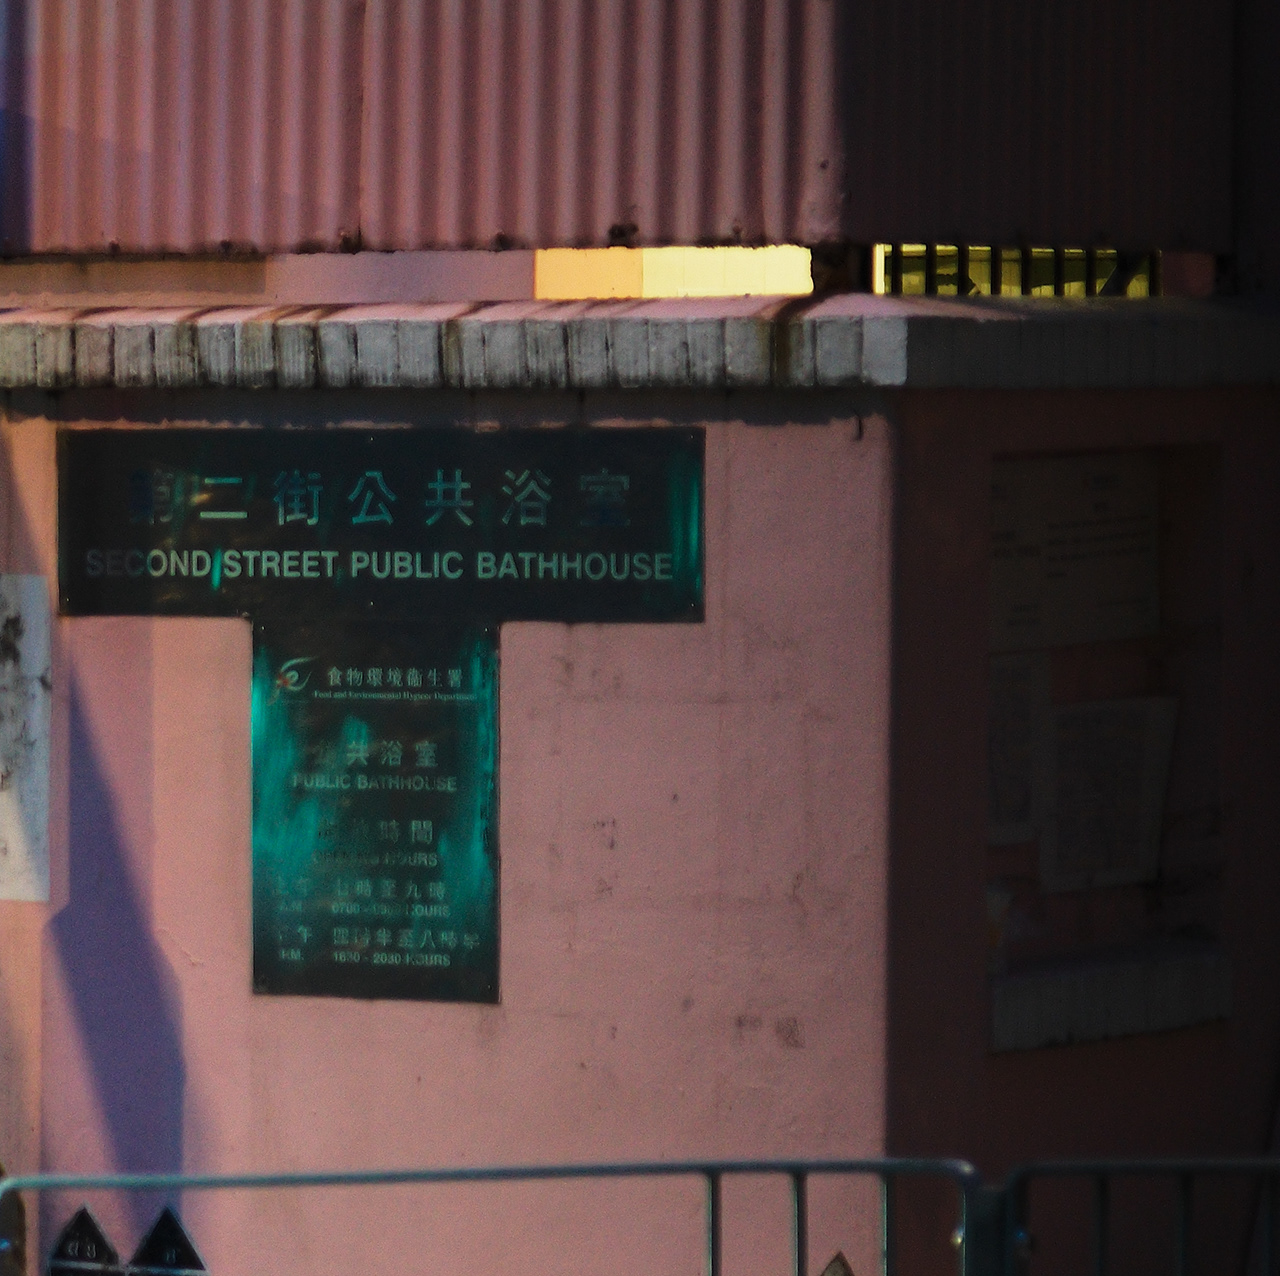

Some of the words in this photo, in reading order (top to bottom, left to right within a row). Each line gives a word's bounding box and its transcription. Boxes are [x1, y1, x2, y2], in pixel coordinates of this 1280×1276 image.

[130, 468, 631, 527] 第二街公共浴室
[85, 549, 214, 579] SECOND
[221, 550, 339, 579] STREET
[351, 551, 464, 580] PUBLIC
[477, 551, 674, 581] BATHHOUSE
[313, 690, 332, 699] Food
[333, 690, 347, 699] and
[348, 691, 401, 700] Environmental
[402, 691, 432, 702] Hygiene
[312, 739, 439, 769] 共浴室
[292, 774, 351, 790] PUBLIC
[356, 775, 458, 792] BATHHOUSE
